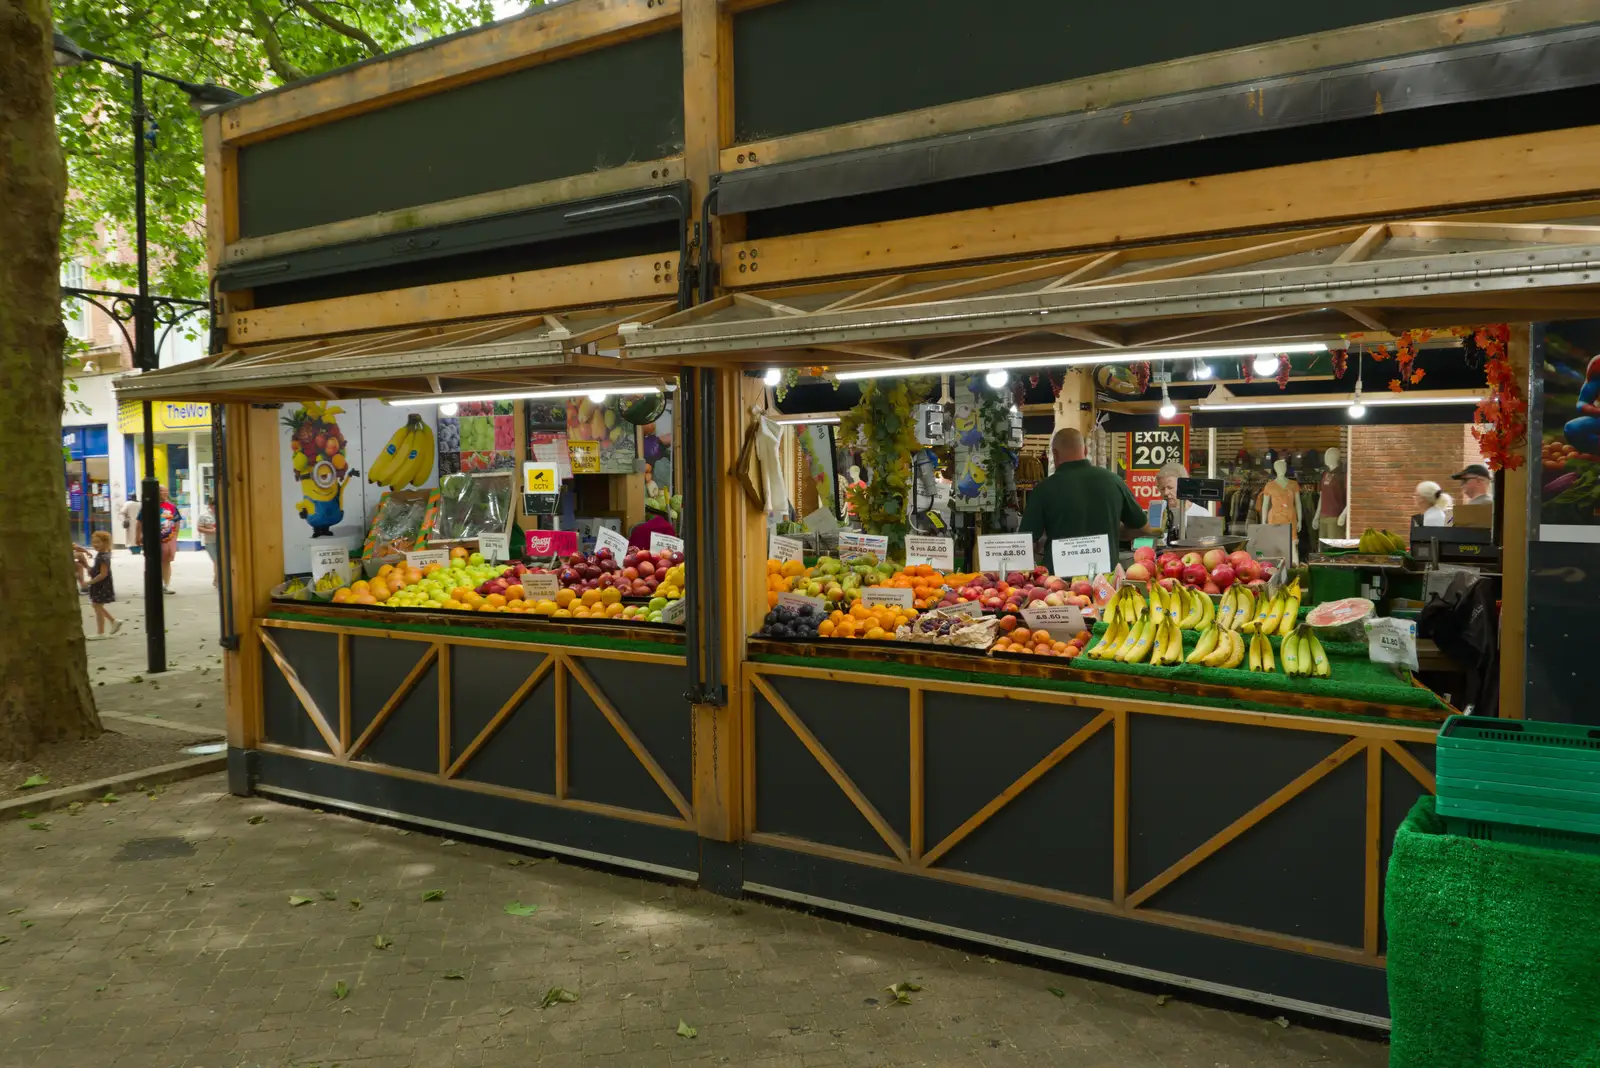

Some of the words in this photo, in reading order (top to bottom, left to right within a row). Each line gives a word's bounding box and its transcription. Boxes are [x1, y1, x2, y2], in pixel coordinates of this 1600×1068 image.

[1135, 431, 1180, 443] EXTRA
[1135, 445, 1180, 465] 20%
[927, 545, 947, 553] £2.00
[1079, 547, 1101, 555] £2.50
[320, 557, 344, 565] £1.00
[1381, 636, 1398, 646] £1.80
